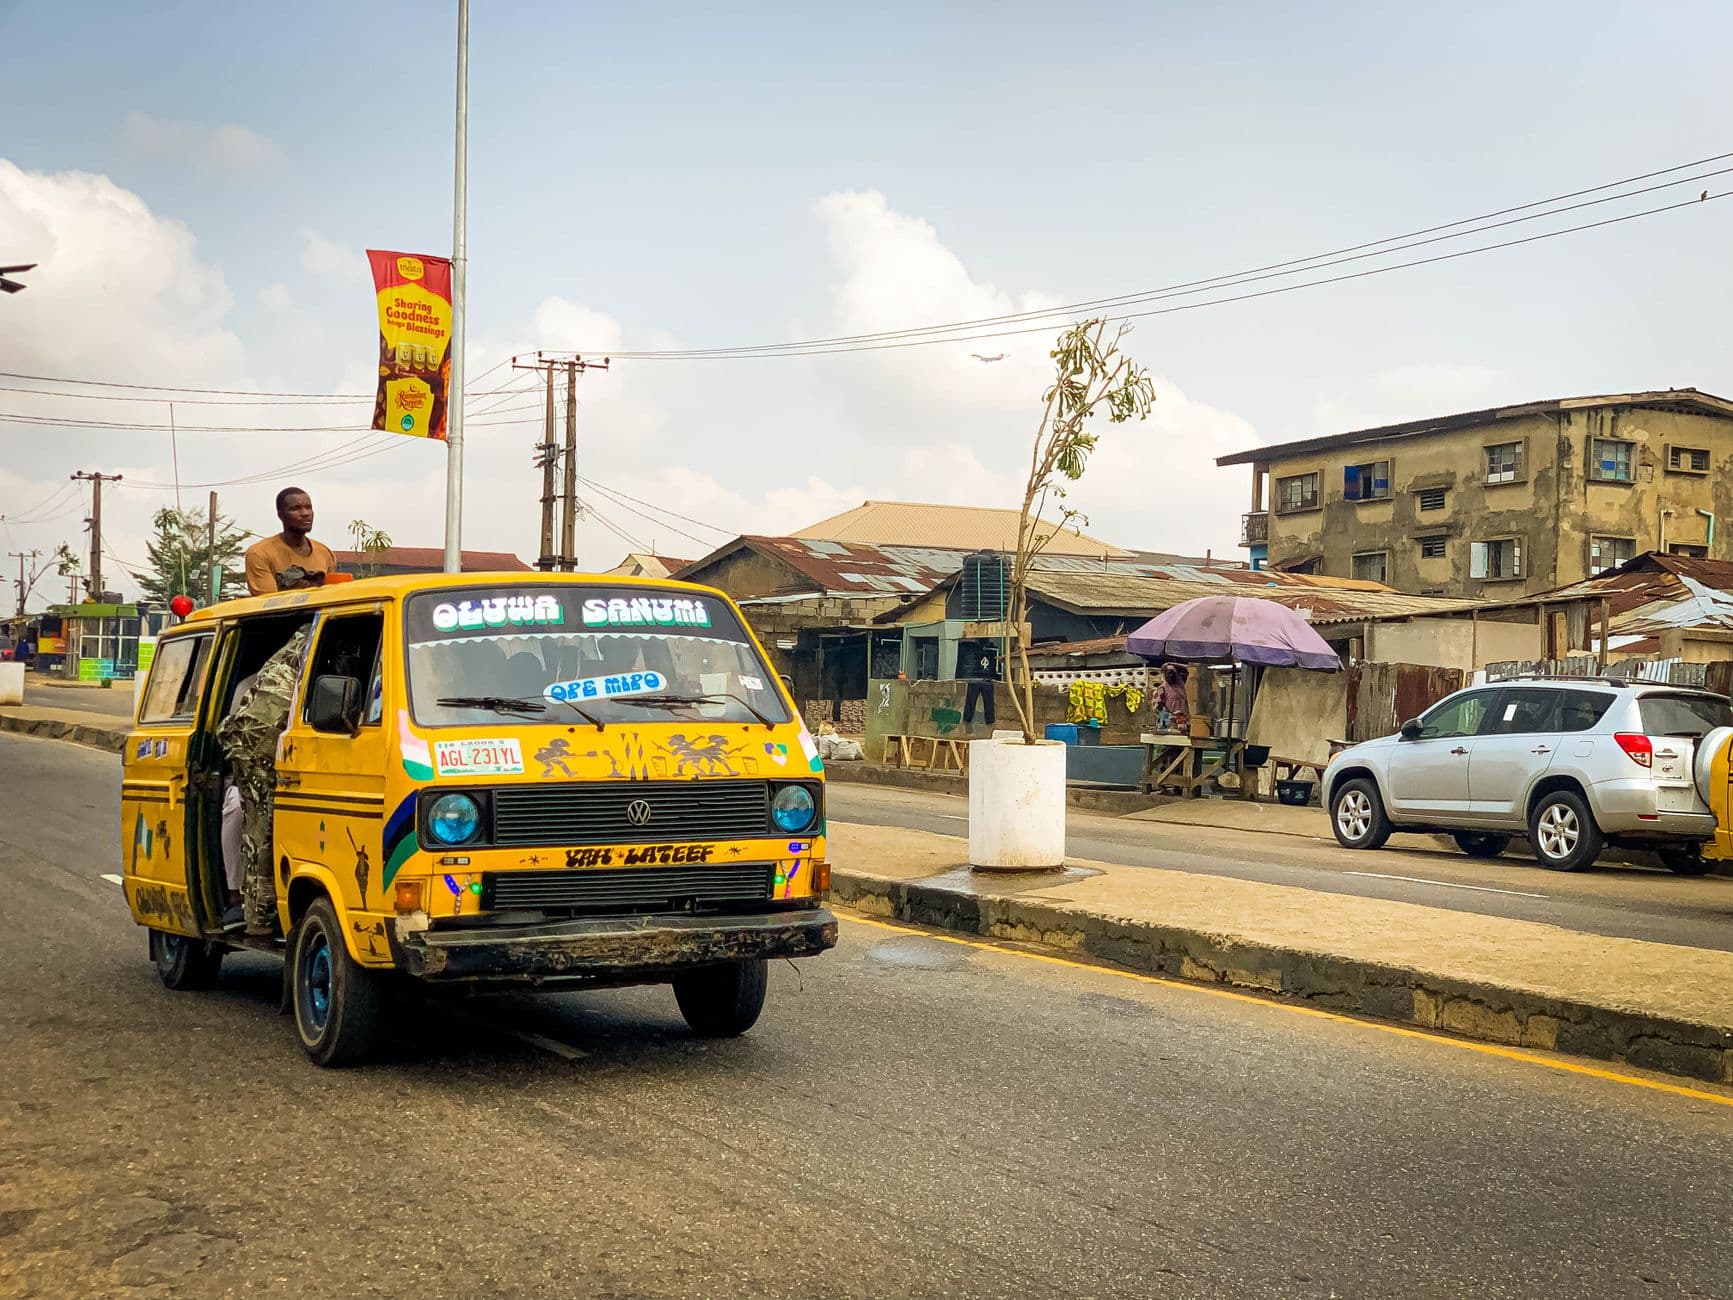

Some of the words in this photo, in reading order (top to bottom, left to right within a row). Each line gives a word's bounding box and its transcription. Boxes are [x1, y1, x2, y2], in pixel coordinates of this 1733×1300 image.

[386, 306, 440, 325] Goodness
[394, 297, 432, 315] Sharing
[406, 322, 445, 339] Blessings
[432, 595, 564, 632] OLUWA
[550, 680, 597, 700] OPE
[624, 844, 716, 865] LATEEF
